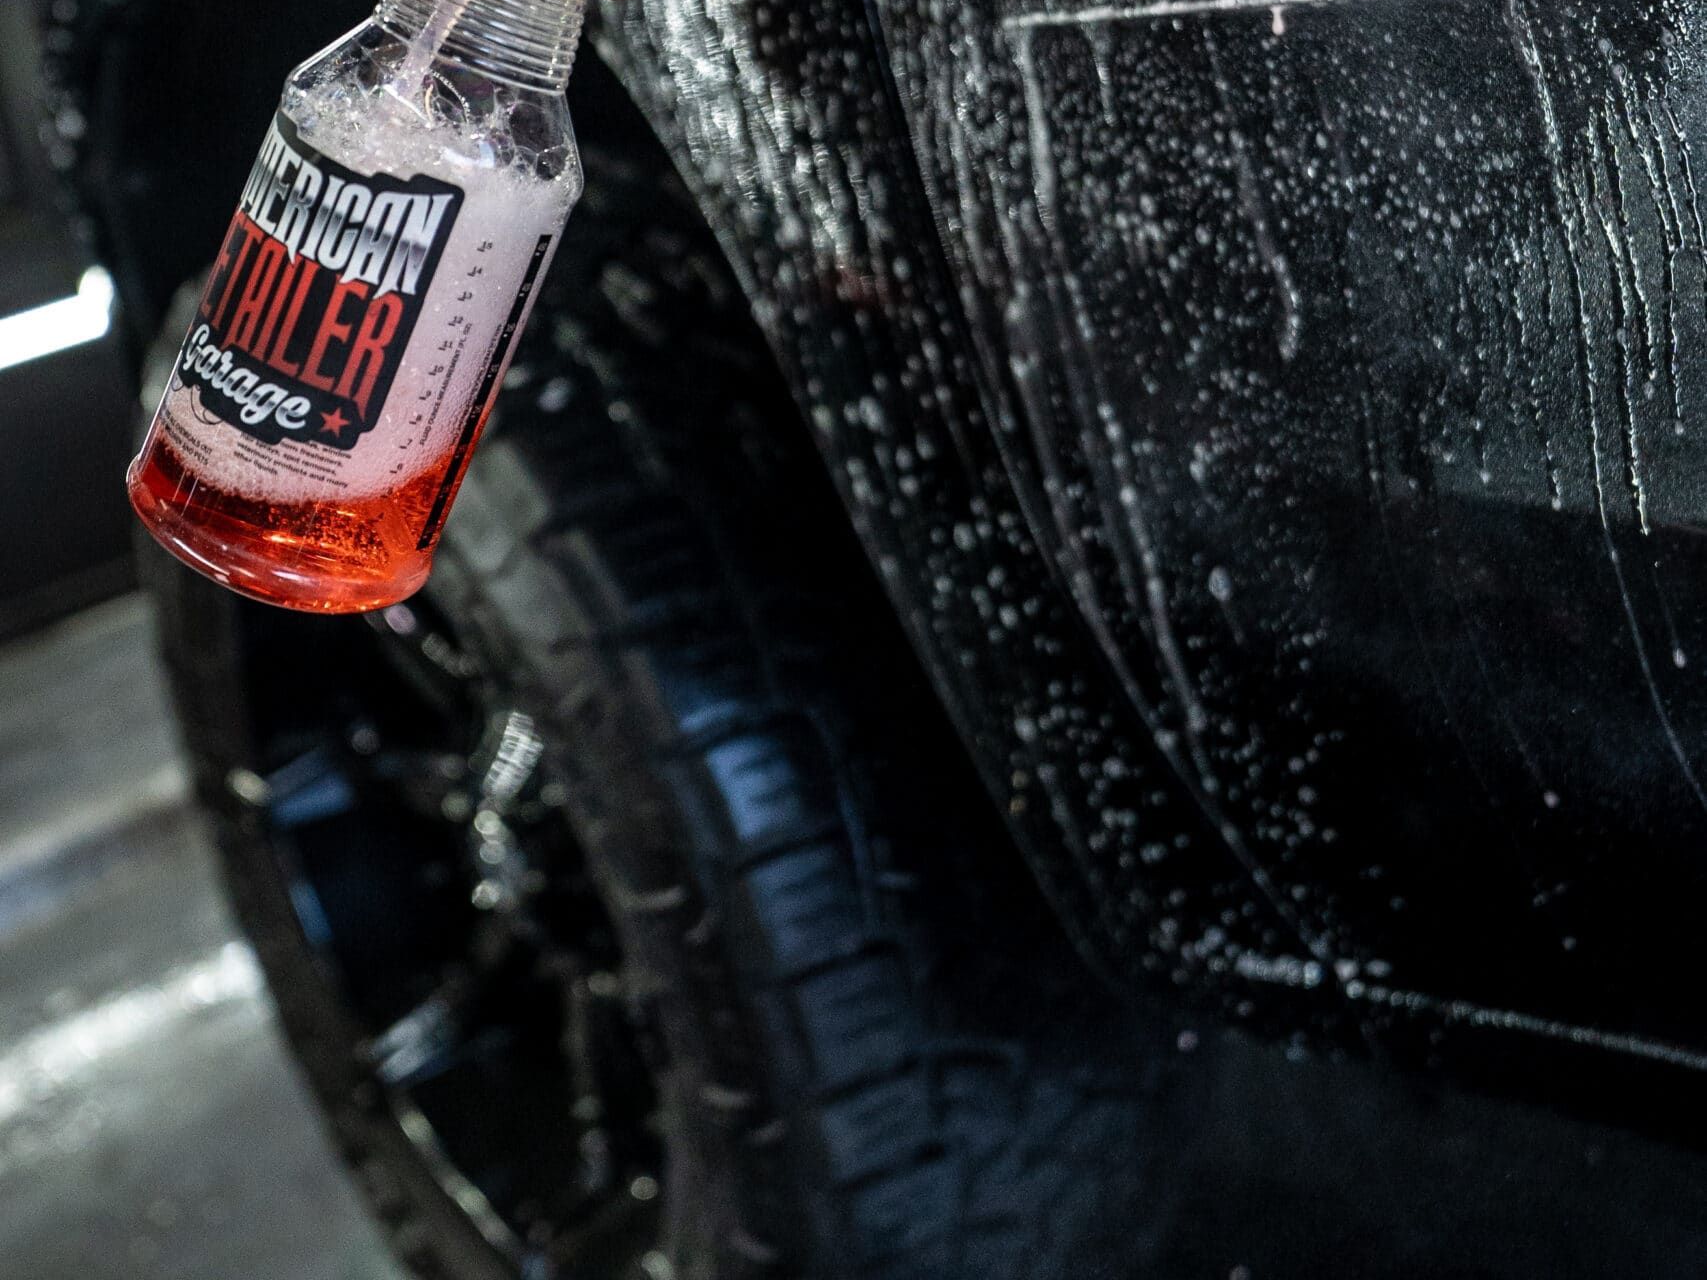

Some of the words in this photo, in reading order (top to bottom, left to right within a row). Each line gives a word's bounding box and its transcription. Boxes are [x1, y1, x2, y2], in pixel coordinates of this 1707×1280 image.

[240, 118, 454, 297] MERICAN
[200, 210, 404, 422] ETAILER
[182, 323, 311, 429] Garage
[437, 349, 460, 401] MEASUREMENT
[273, 459, 307, 476] products
[309, 472, 325, 483] and
[326, 477, 348, 489] many
